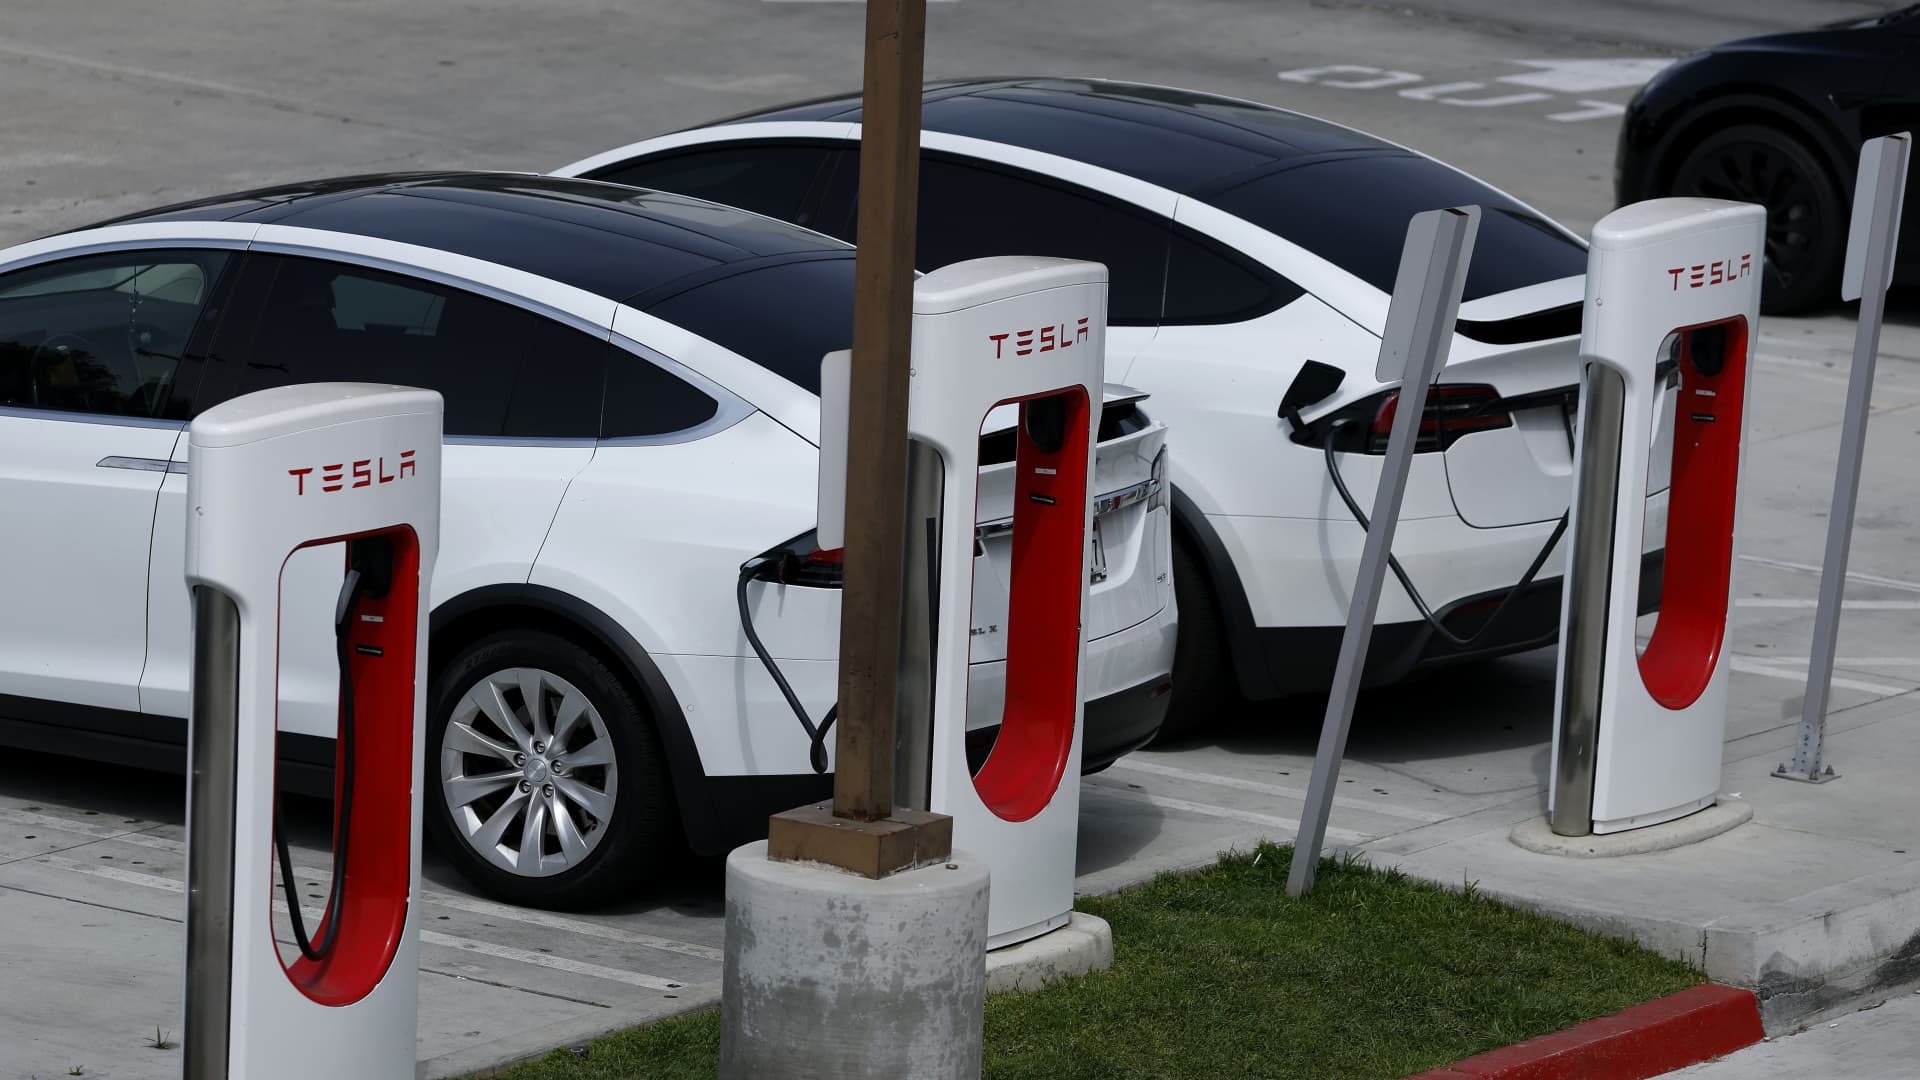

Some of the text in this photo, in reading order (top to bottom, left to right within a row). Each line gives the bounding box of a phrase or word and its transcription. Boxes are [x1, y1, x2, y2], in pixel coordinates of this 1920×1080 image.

[1667, 253, 1751, 291] TESLA
[989, 317, 1089, 359] TESLA
[288, 449, 416, 496] TESLA
